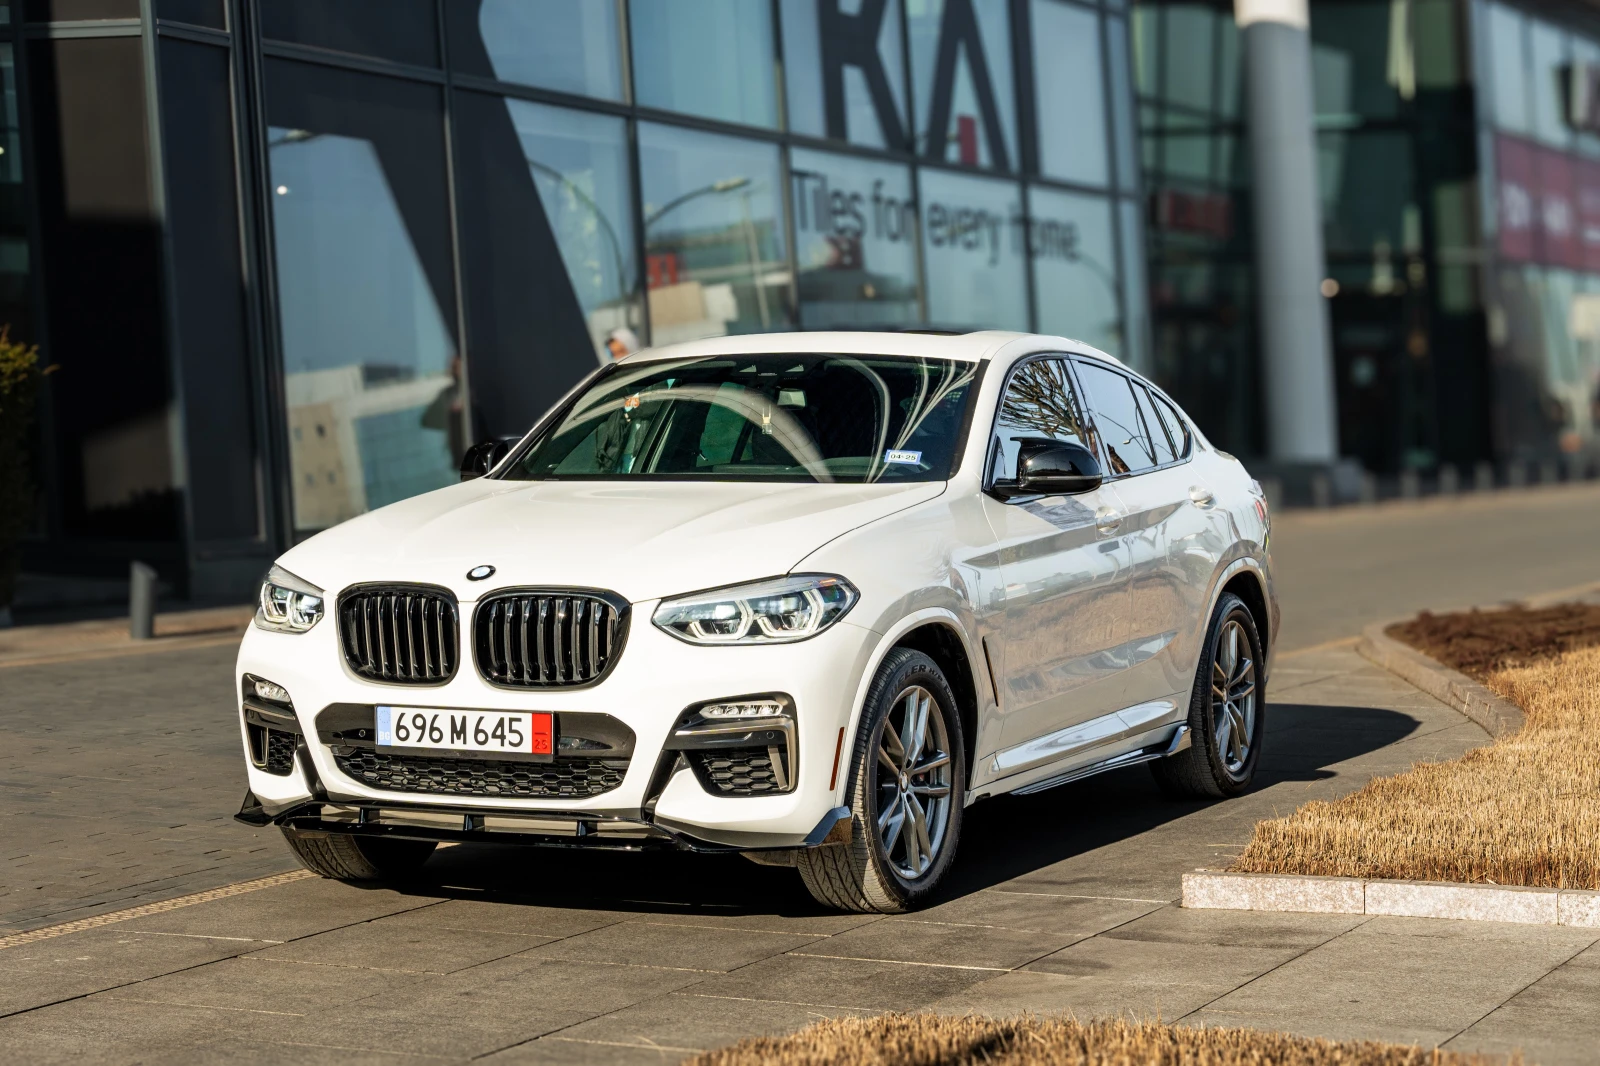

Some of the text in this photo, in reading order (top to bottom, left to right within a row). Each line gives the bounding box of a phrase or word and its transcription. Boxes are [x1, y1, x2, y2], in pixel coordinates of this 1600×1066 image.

[872, 178, 918, 244] for
[927, 202, 1003, 269] every
[890, 453, 916, 461] 04-25
[395, 712, 524, 748] 696 M 645
[379, 731, 391, 740] BG
[534, 739, 548, 749] 25
